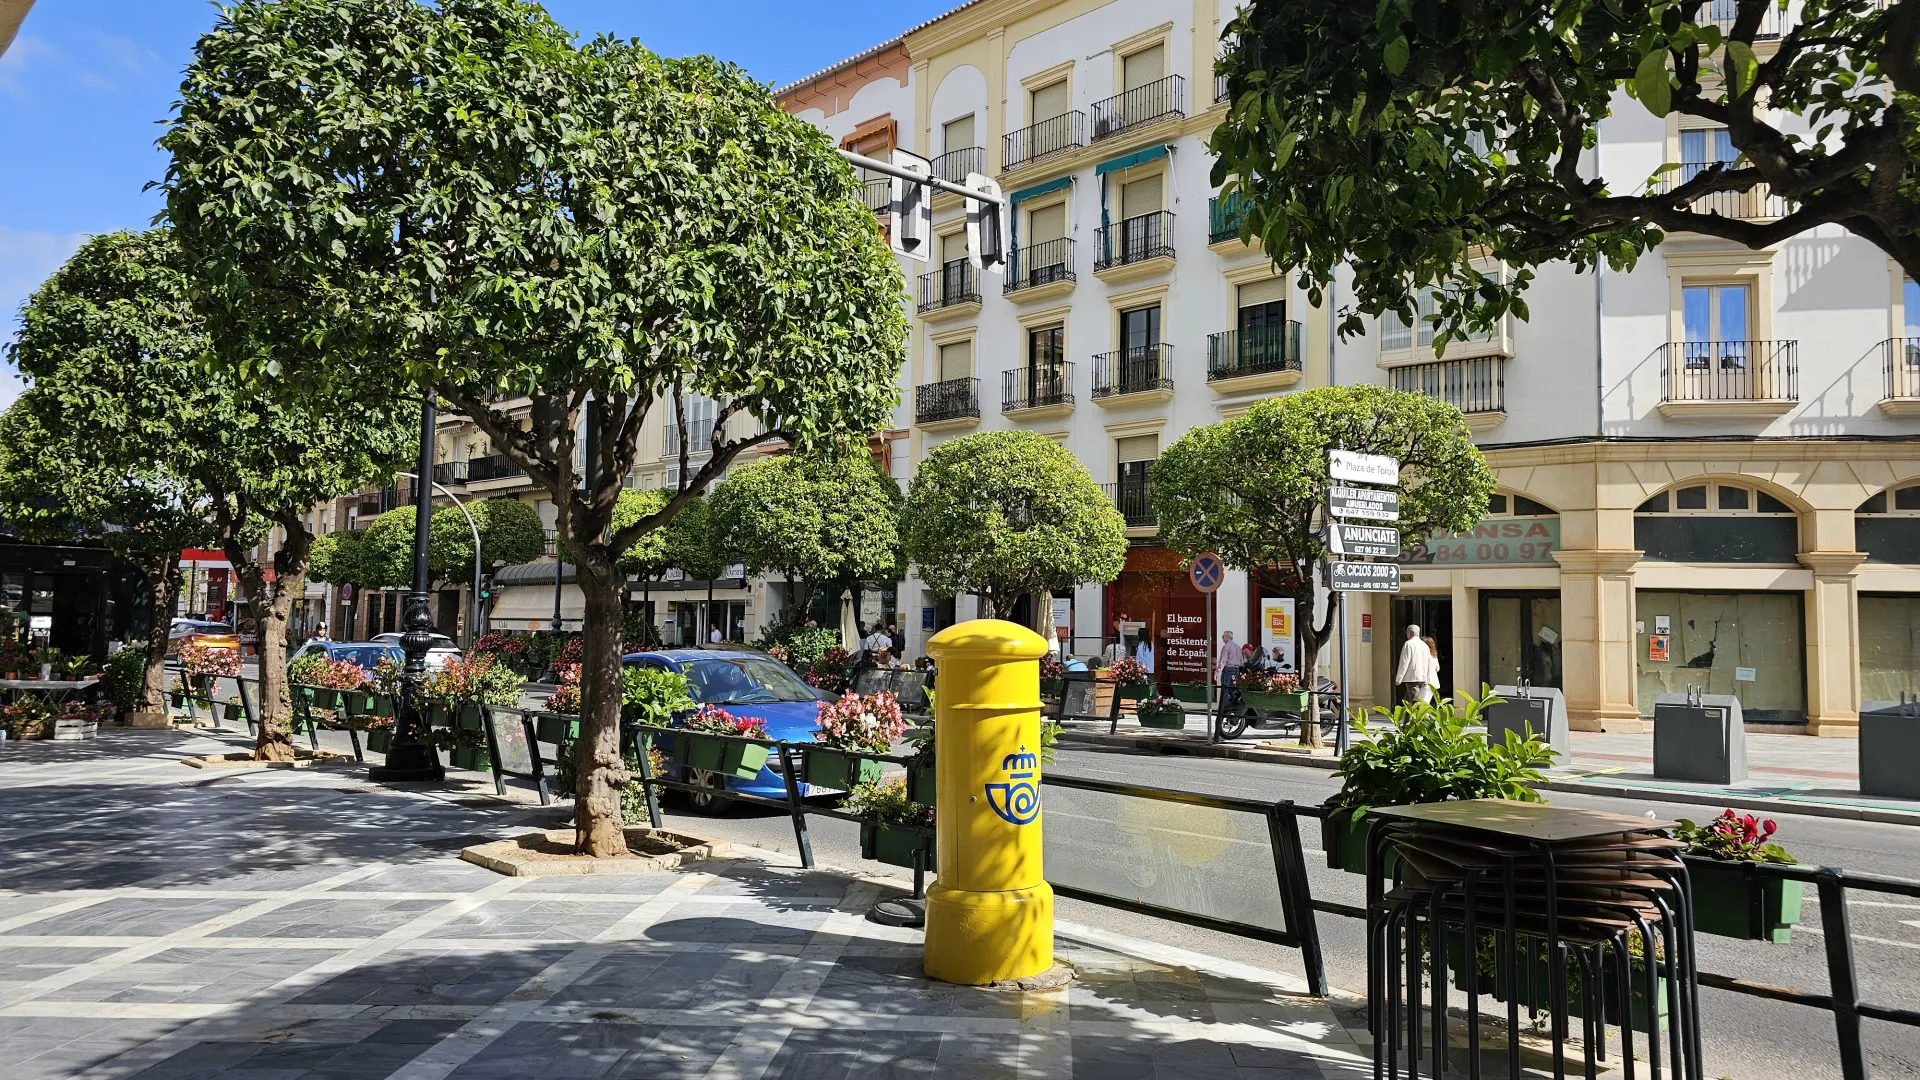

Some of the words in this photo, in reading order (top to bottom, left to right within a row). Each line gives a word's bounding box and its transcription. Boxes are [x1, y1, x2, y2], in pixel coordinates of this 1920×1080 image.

[1346, 462, 1365, 472] Plaza
[1366, 465, 1375, 473] de
[1377, 466, 1396, 476] Toros
[1331, 487, 1357, 499] ALQUILER
[1358, 490, 1397, 504] APARTAMENTOS
[1345, 500, 1384, 510] AMUEBLADOS
[1344, 527, 1396, 543] ANUNCIATE
[1436, 544, 1468, 561] 84
[1476, 543, 1510, 561] 00
[1519, 542, 1553, 560] 97
[1346, 564, 1371, 577] CICLOS
[1372, 565, 1389, 578] 2000
[1167, 613, 1176, 623] El
[1177, 613, 1202, 623] banco
[1167, 625, 1184, 634] más
[1166, 636, 1208, 646] resistente
[1167, 647, 1177, 656] de
